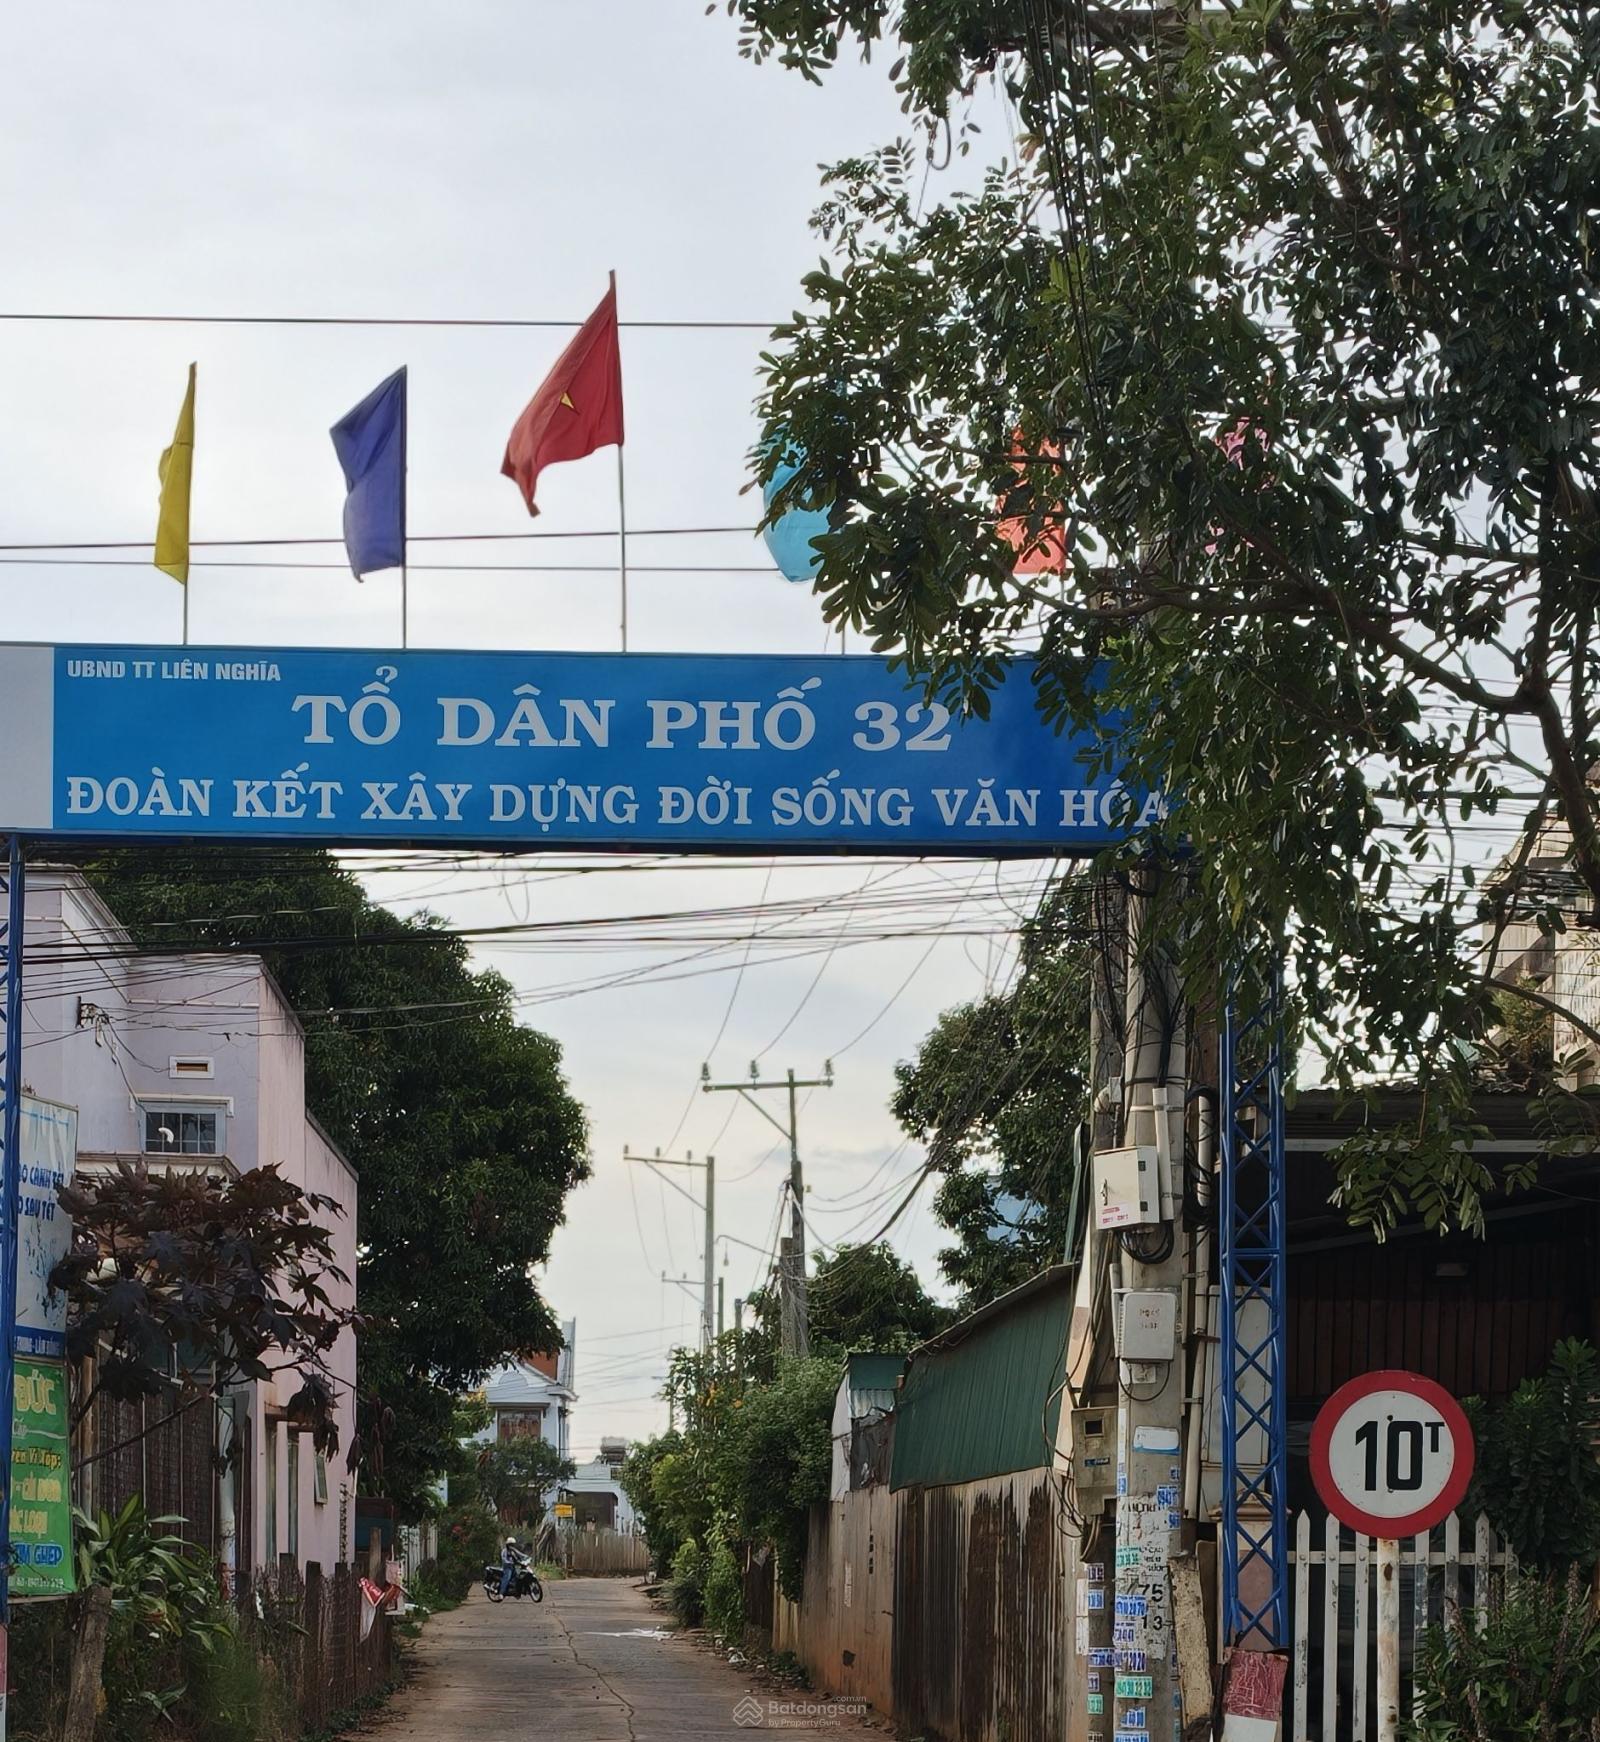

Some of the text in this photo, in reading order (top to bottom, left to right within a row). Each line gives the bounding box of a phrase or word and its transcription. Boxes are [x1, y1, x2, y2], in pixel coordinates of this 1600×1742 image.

[67, 658, 281, 681] UBND TT LIÊN NGHĨA
[291, 665, 952, 751] TỔ DÂN PHỐ 32
[66, 766, 214, 817] ĐOÀN
[232, 762, 343, 819] KẾT
[360, 771, 473, 822] XÂY
[489, 777, 640, 831] DỰNG
[658, 775, 752, 825] ĐỜI
[771, 769, 914, 827] SỐNG
[931, 777, 1042, 827] VĂN
